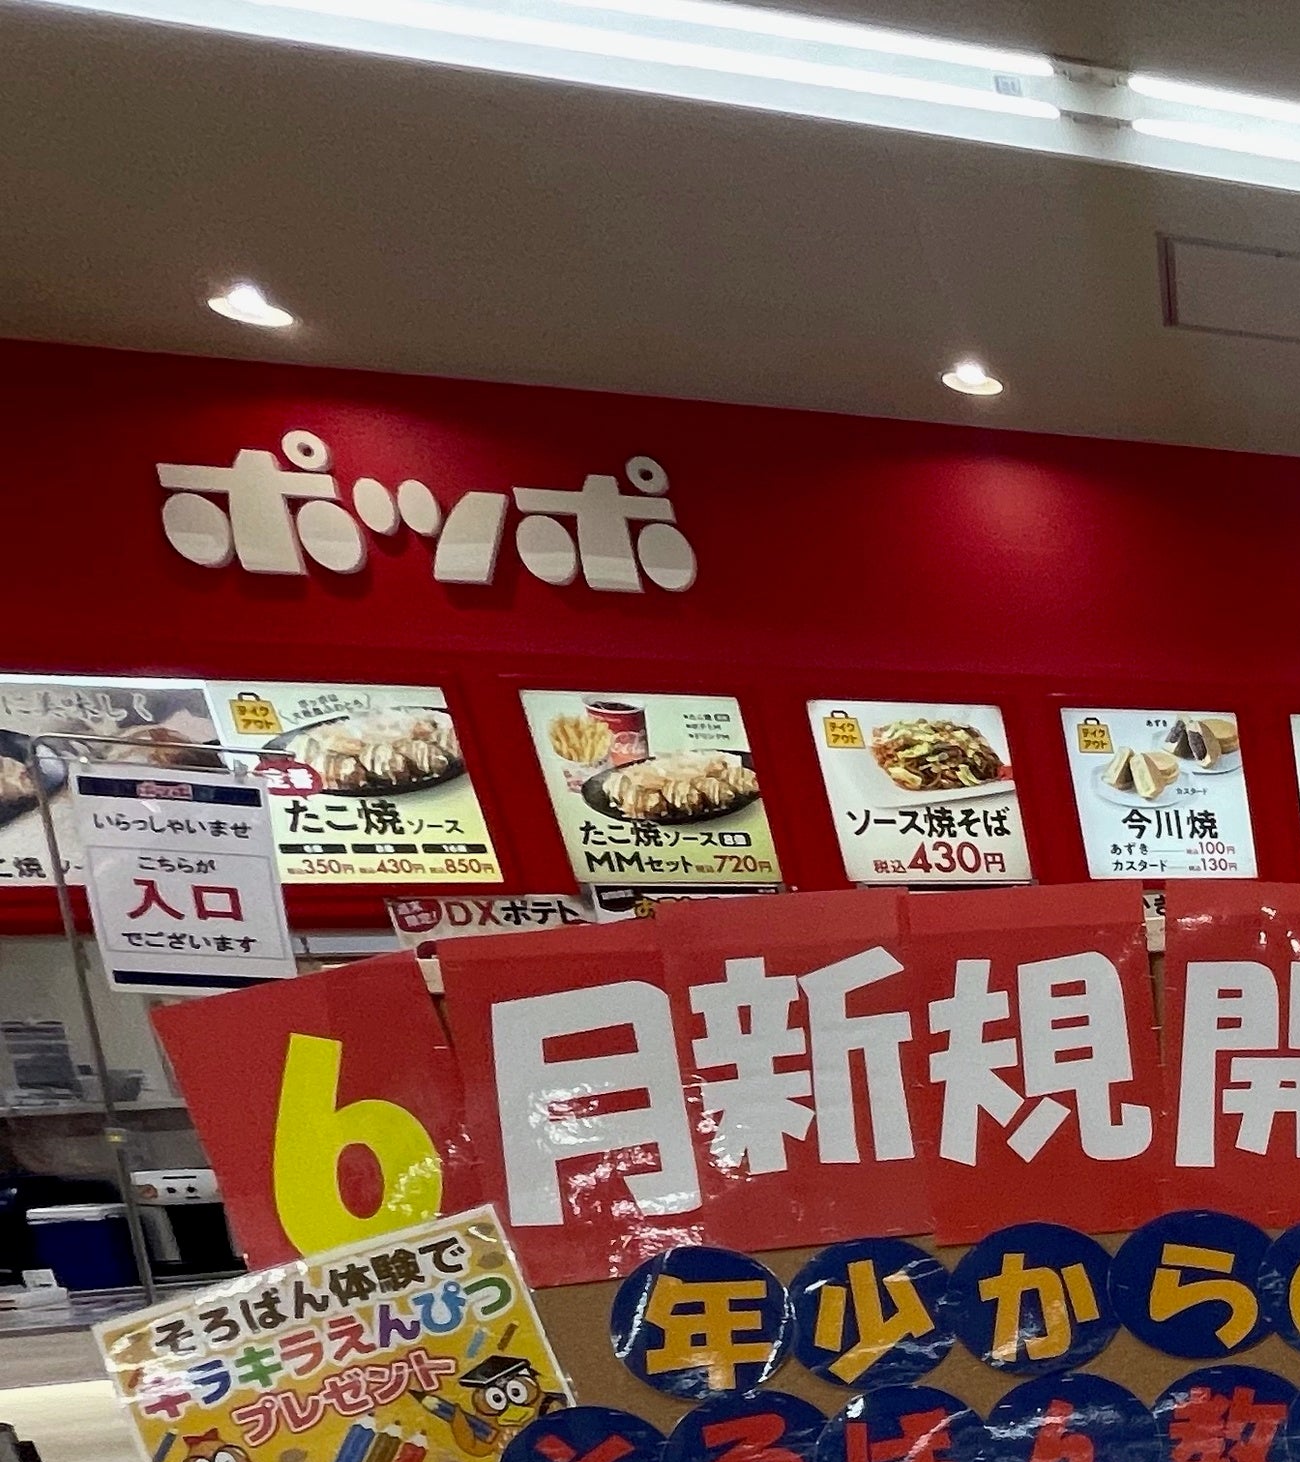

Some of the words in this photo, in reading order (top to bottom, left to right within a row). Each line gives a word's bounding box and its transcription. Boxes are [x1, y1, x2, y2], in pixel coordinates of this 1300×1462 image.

[156, 429, 697, 592] ポッポ
[93, 813, 252, 839] いらっしゃいませ
[284, 799, 465, 835] たこ焼ソース
[846, 806, 1012, 838] ソース焼そば
[1121, 808, 1219, 840] 今川焼
[580, 821, 719, 848] たこ焼ソース
[1110, 842, 1149, 856] あずき
[138, 856, 217, 875] こちらが
[586, 850, 693, 874] MMセット
[873, 841, 1006, 874] 税込430円
[1112, 859, 1168, 872] カスタード
[127, 878, 244, 923] 入口
[447, 900, 581, 926] DXポテト
[121, 931, 258, 953] でございます
[153, 1236, 468, 1354] そろばん体験で
[143, 1277, 513, 1419] キラキラえんぴつ
[231, 1347, 458, 1447] プレゼント
